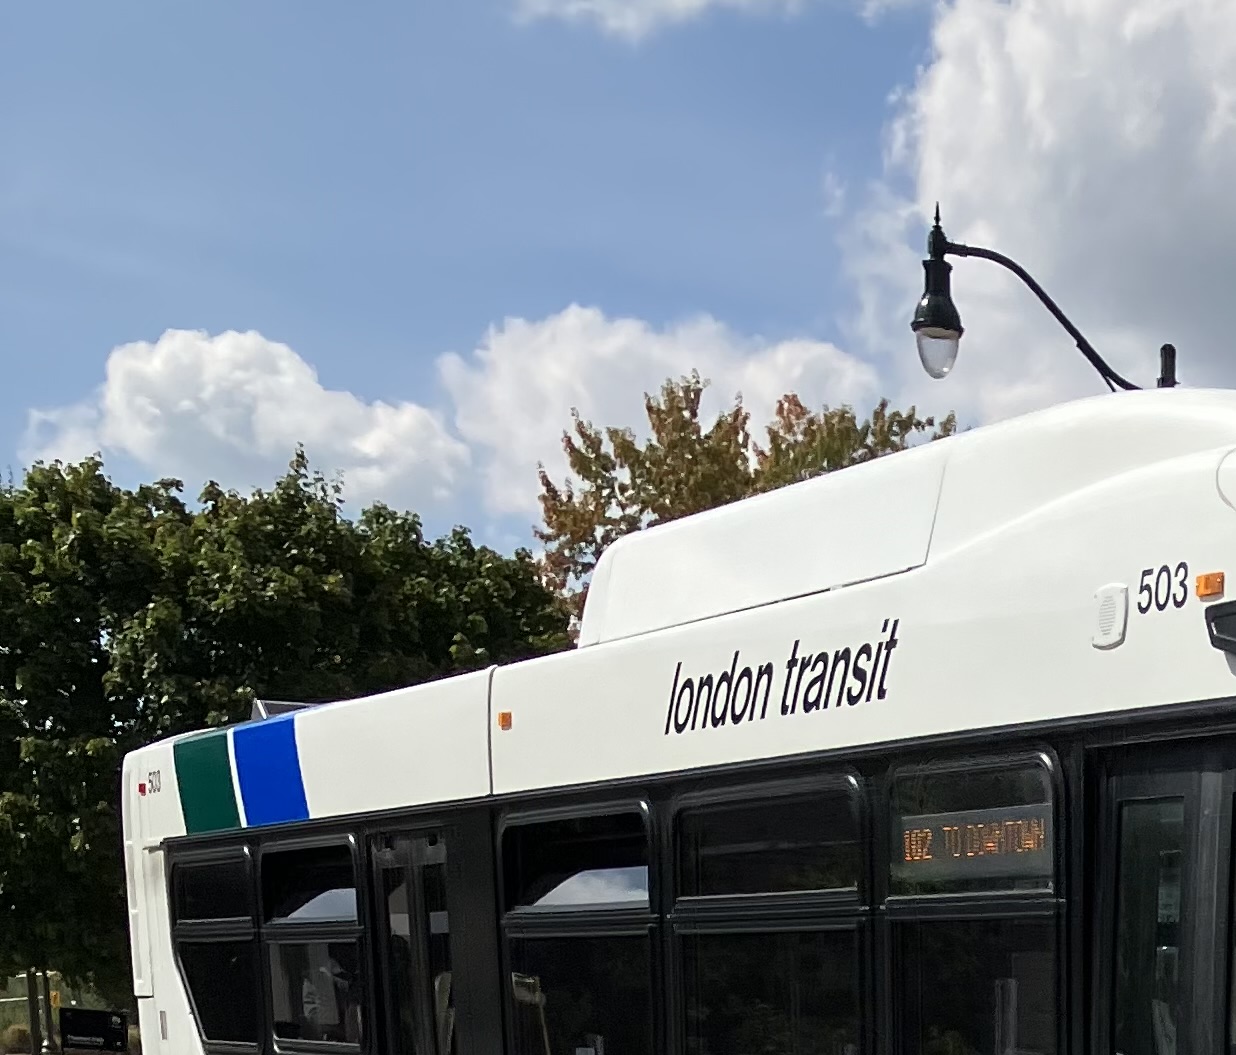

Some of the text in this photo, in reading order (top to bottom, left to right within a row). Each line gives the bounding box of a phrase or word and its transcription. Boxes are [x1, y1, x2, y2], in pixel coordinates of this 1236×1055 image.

[1137, 561, 1188, 614] 503
[664, 618, 900, 735] london transit
[904, 828, 933, 861] 102
